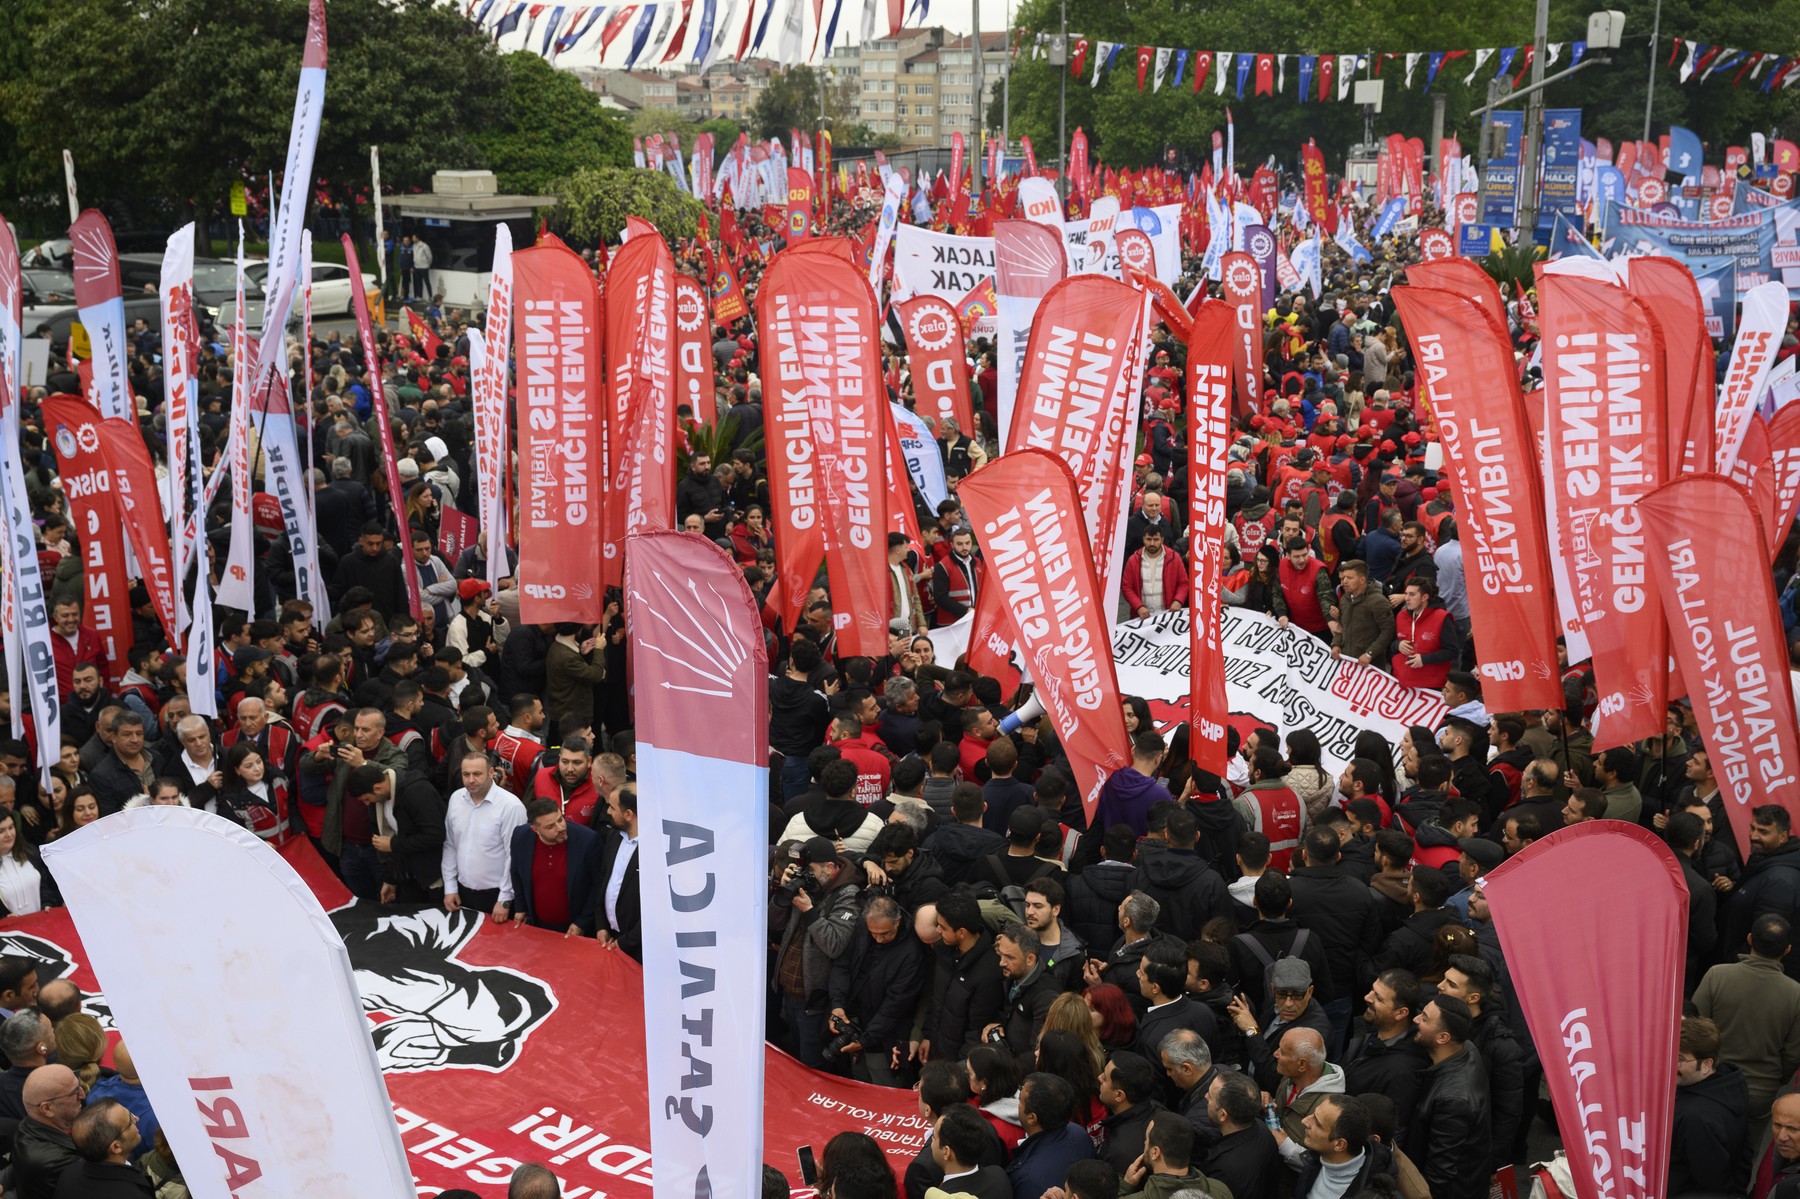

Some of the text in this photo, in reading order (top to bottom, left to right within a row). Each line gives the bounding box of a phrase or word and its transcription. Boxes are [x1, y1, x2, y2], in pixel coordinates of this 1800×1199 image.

[1034, 325, 1079, 420] EMİN
[1061, 331, 1117, 475] SENİN!
[776, 387, 816, 531] GENÇLİK
[1206, 364, 1228, 528] SENİN!
[1191, 364, 1212, 641] GENÇLİK EMİN
[988, 633, 1009, 657] CHP
[1233, 614, 1448, 736] ZGÜRLEŞSİN
[1200, 717, 1224, 742] CHP
[500, 759, 511, 771] HP
[807, 1092, 932, 1131] ENÇLİK KOLLARI
[862, 1126, 925, 1148] TANBUL
[885, 1147, 921, 1157] CHP
